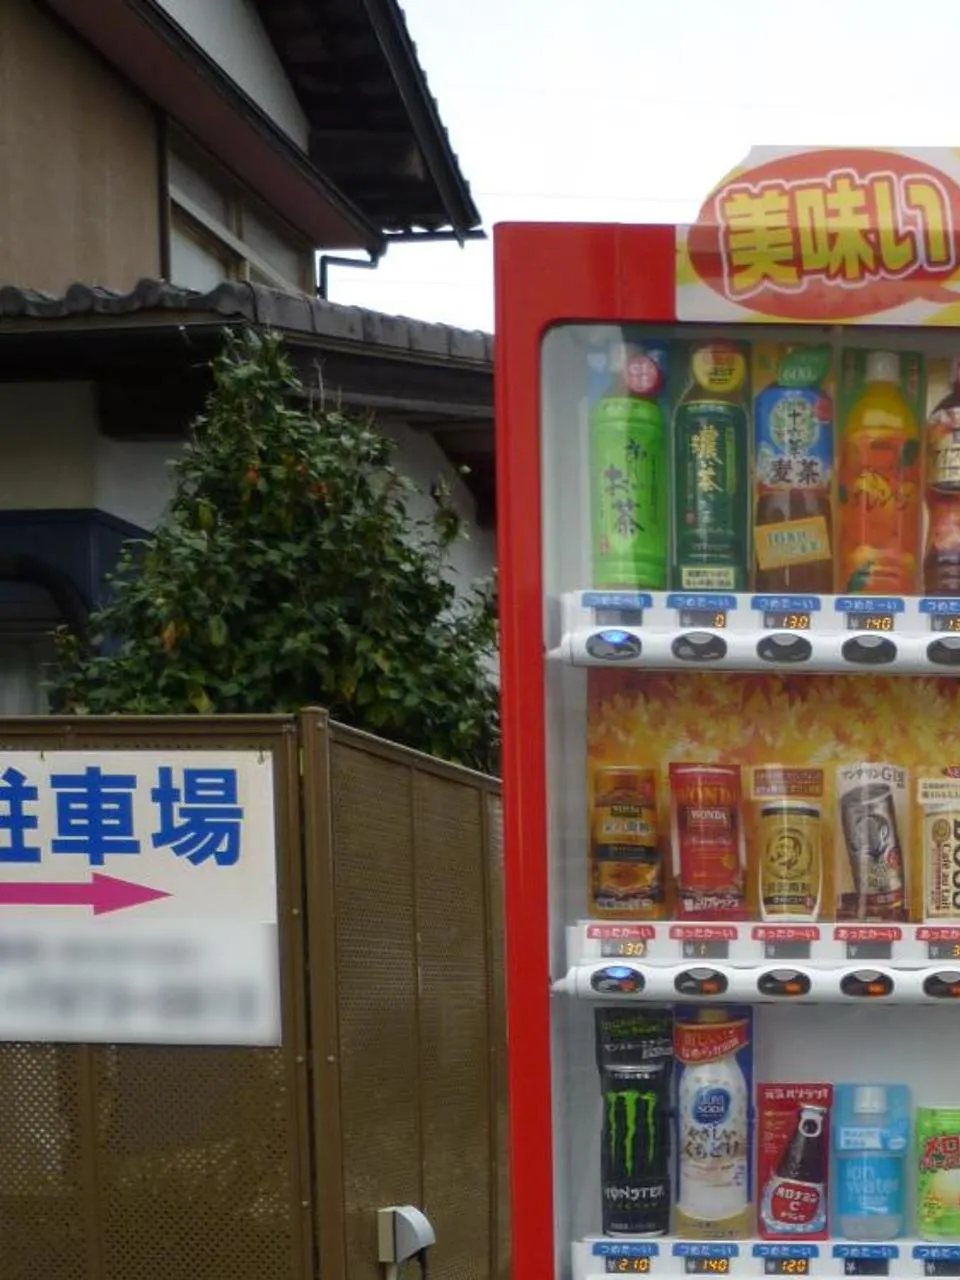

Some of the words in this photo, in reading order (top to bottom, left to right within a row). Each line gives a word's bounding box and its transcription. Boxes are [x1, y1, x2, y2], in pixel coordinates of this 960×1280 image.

[722, 174, 953, 296] 美味い
[768, 457, 822, 486] 麦茶
[619, 1259, 649, 1272] 210
[782, 1259, 806, 1272] 120
